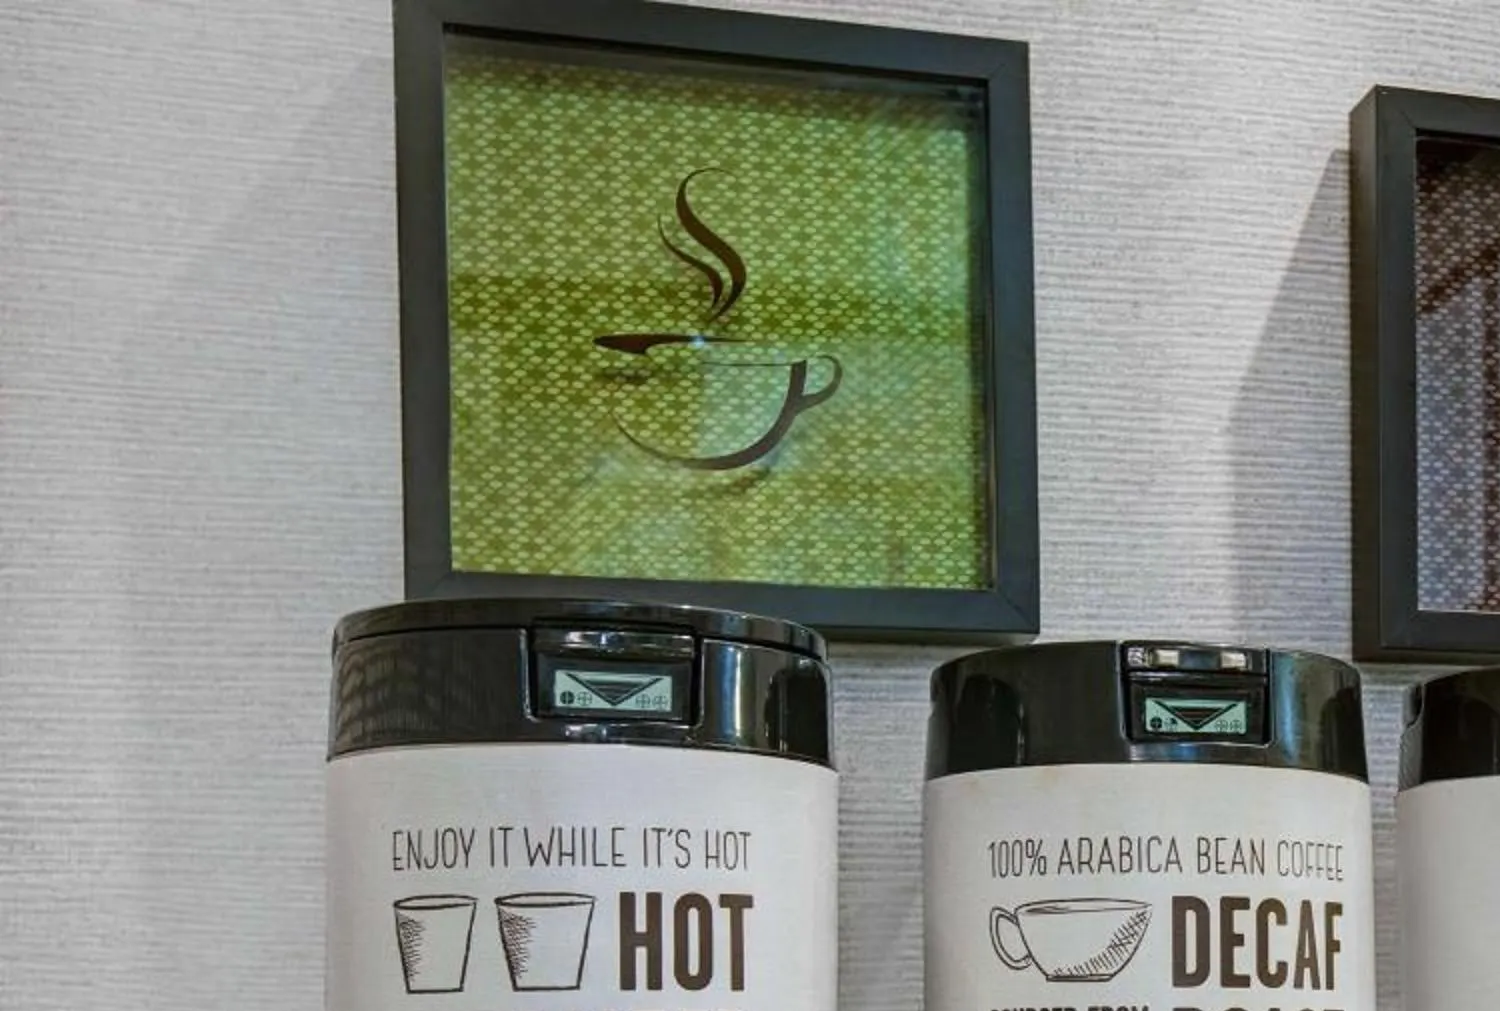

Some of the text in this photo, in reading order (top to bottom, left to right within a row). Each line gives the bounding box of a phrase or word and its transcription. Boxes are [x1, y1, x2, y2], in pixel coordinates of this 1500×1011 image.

[393, 827, 751, 871] ENJOY IT WHILE IT'S HOT
[989, 836, 1343, 882] 100% ARABICA BEAN COFFEE
[620, 892, 753, 991] HOT
[1172, 896, 1343, 990] DECAF
